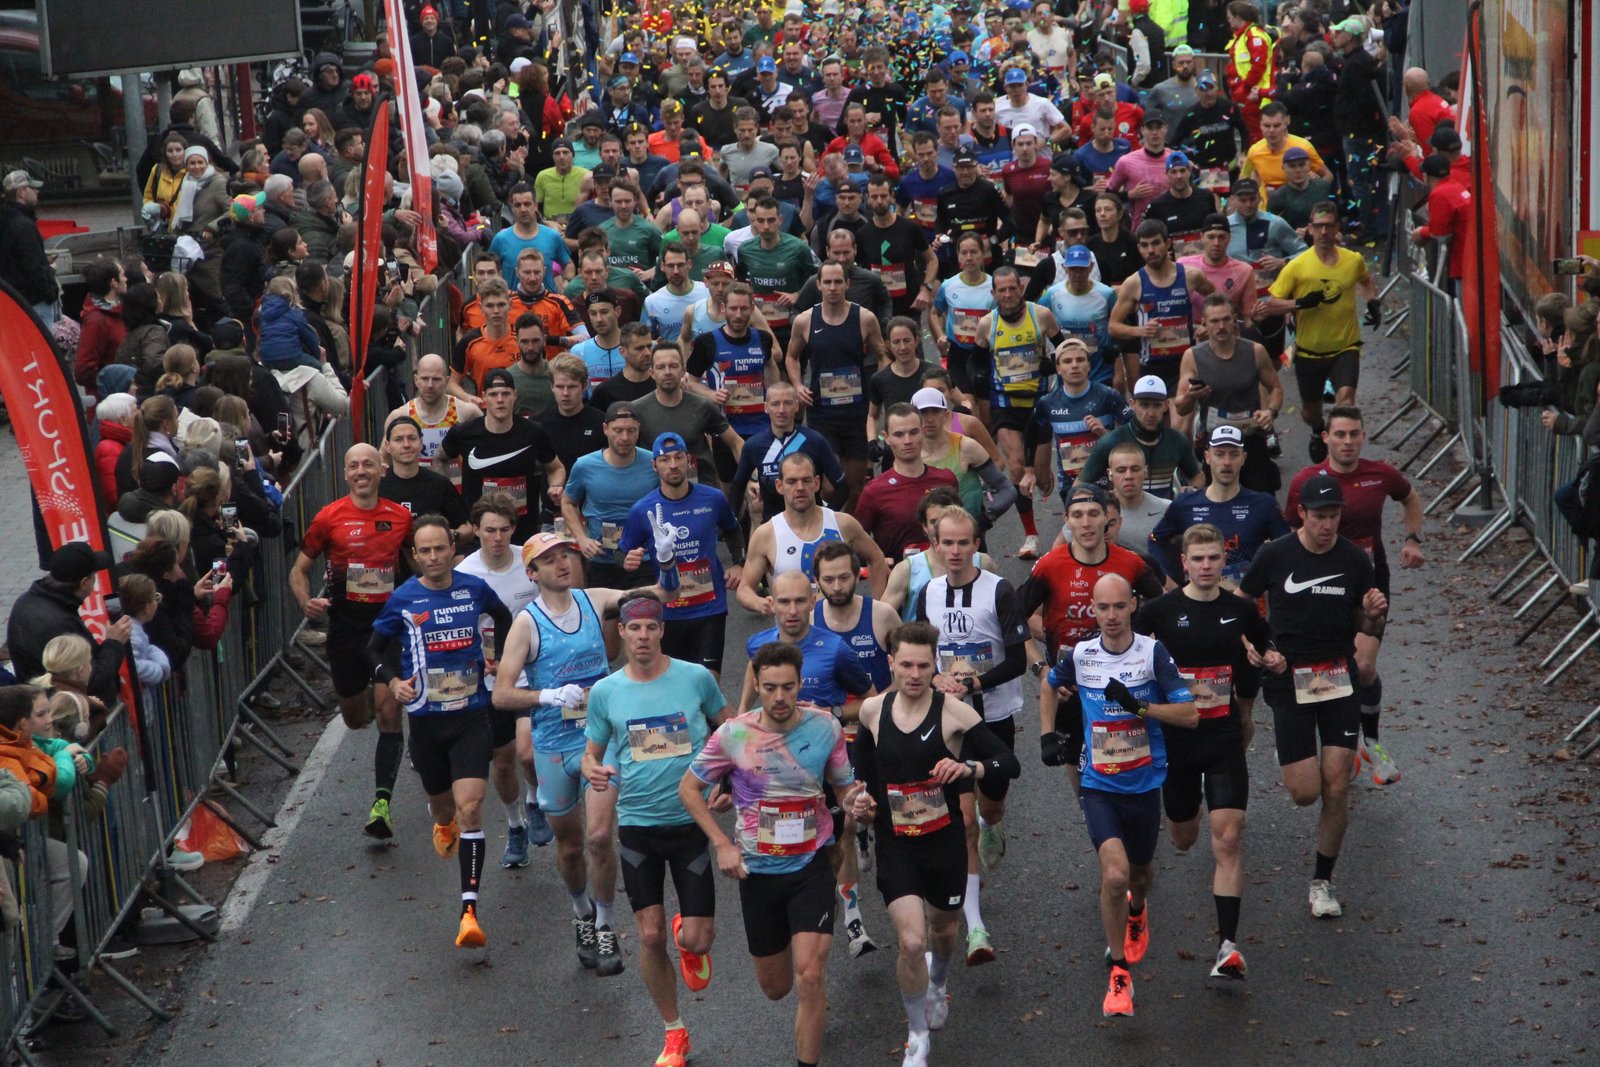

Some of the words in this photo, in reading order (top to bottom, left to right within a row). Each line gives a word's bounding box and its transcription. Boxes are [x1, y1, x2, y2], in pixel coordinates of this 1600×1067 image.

[753, 276, 787, 287] TORENS
[734, 355, 765, 365] runners'
[735, 363, 749, 371] lab
[674, 540, 700, 550] NISHER
[1311, 585, 1346, 596] TRAINING
[433, 600, 475, 616] runners'
[435, 614, 454, 625] lab
[948, 610, 968, 633] Pit
[425, 627, 473, 643] HEYLEN
[651, 742, 667, 751] Stef
